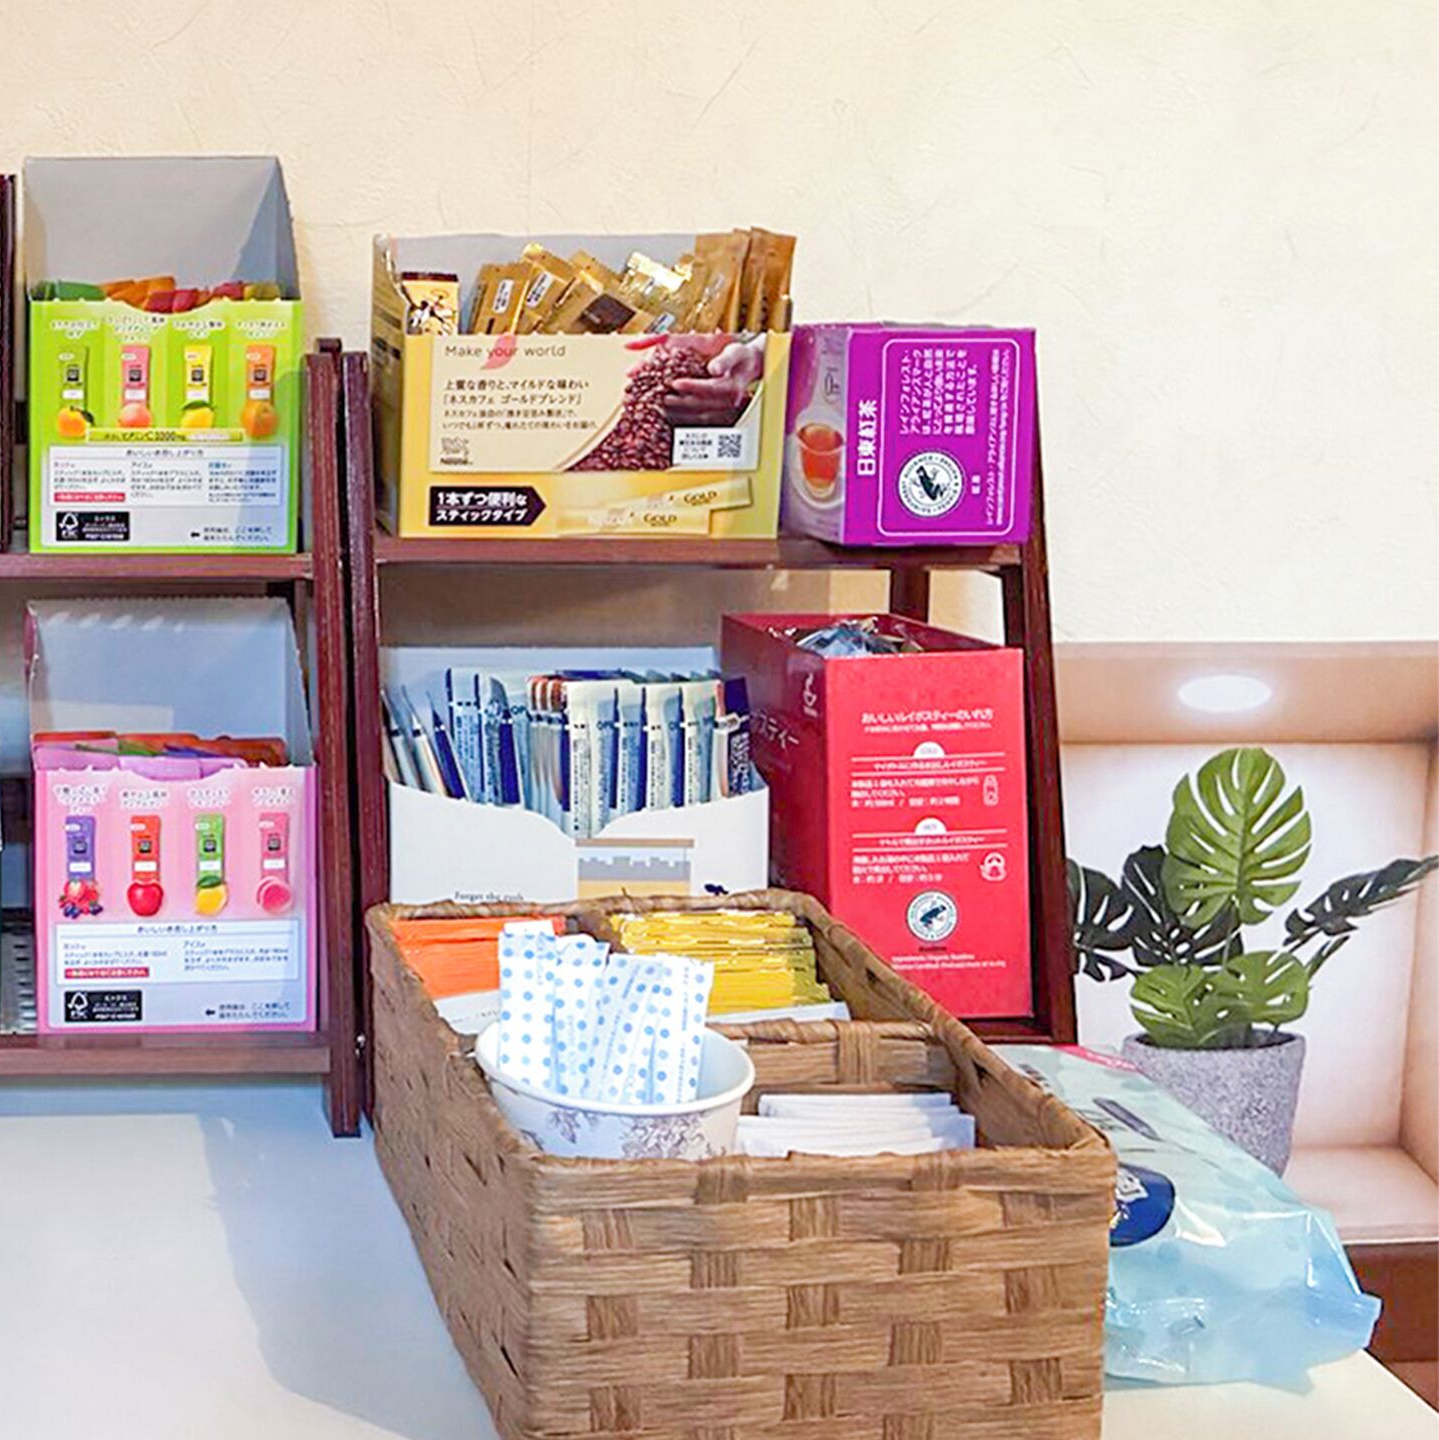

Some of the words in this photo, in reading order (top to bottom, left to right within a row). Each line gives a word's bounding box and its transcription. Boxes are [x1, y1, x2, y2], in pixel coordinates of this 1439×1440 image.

[444, 345, 483, 358] Make
[487, 347, 518, 361] your
[524, 345, 566, 357] world
[857, 400, 878, 476] 日東紅茶
[437, 491, 528, 507] 1本ずつ便利な
[436, 509, 529, 521] スティックタイプ
[643, 512, 678, 524] GOLD
